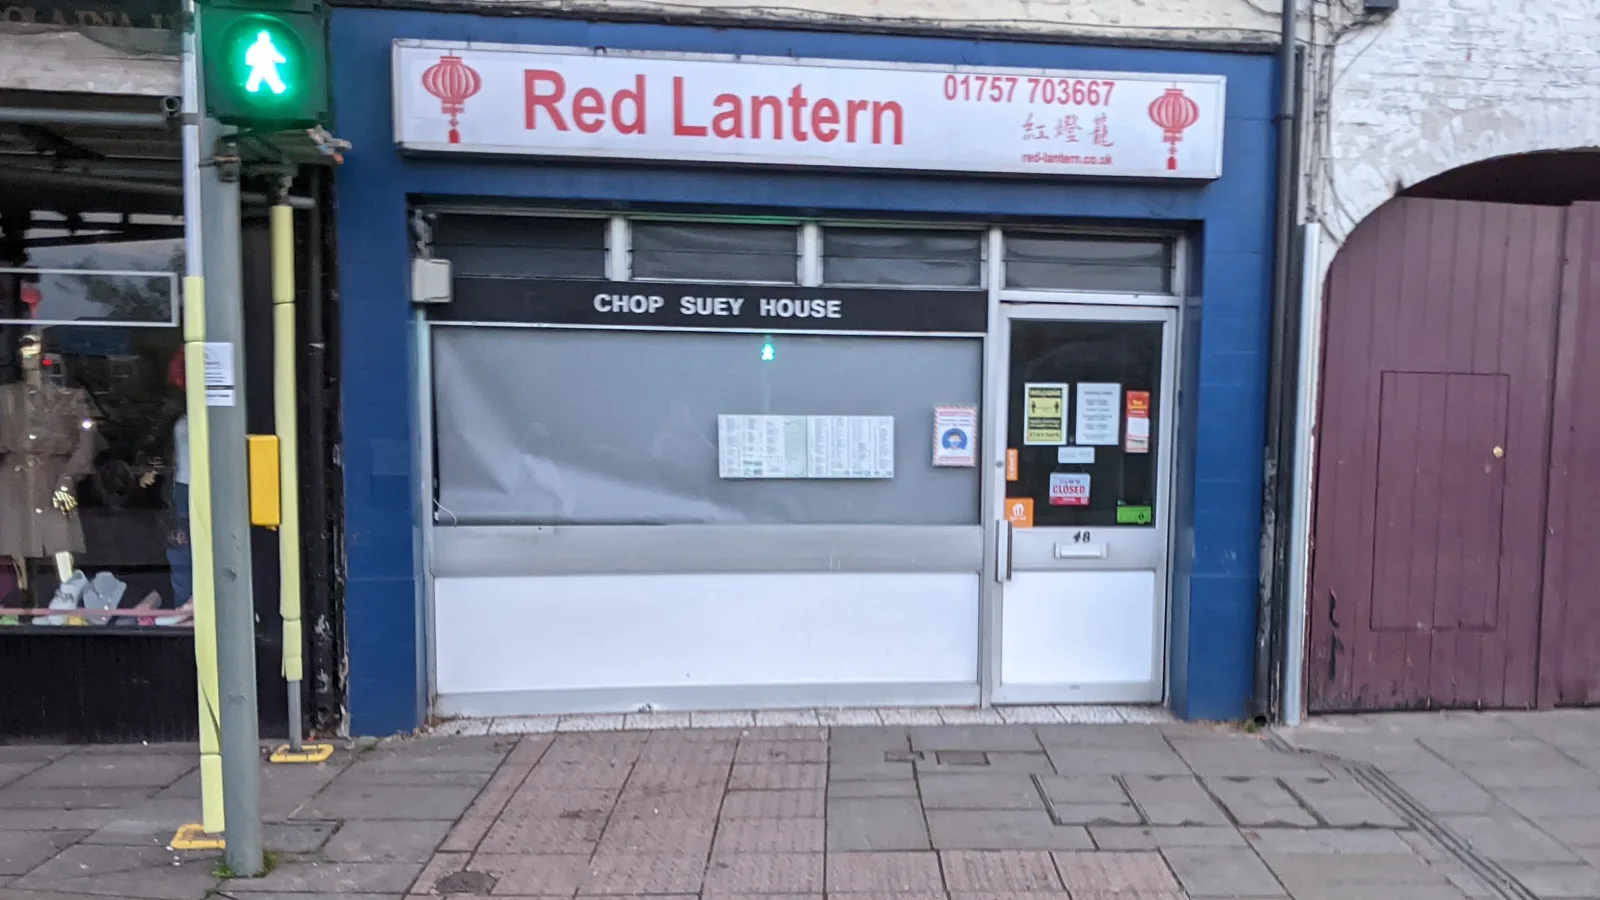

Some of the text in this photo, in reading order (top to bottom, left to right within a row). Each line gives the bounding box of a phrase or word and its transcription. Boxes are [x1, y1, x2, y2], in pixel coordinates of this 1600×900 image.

[944, 74, 1115, 106] 01757 703667
[523, 69, 904, 145] Red Lantern
[1022, 152, 1113, 166] red-lantern.co.uk
[593, 293, 842, 319] CHOP SUEY HOUSE
[1052, 485, 1085, 495] CLOSED
[1073, 530, 1091, 543] 48
